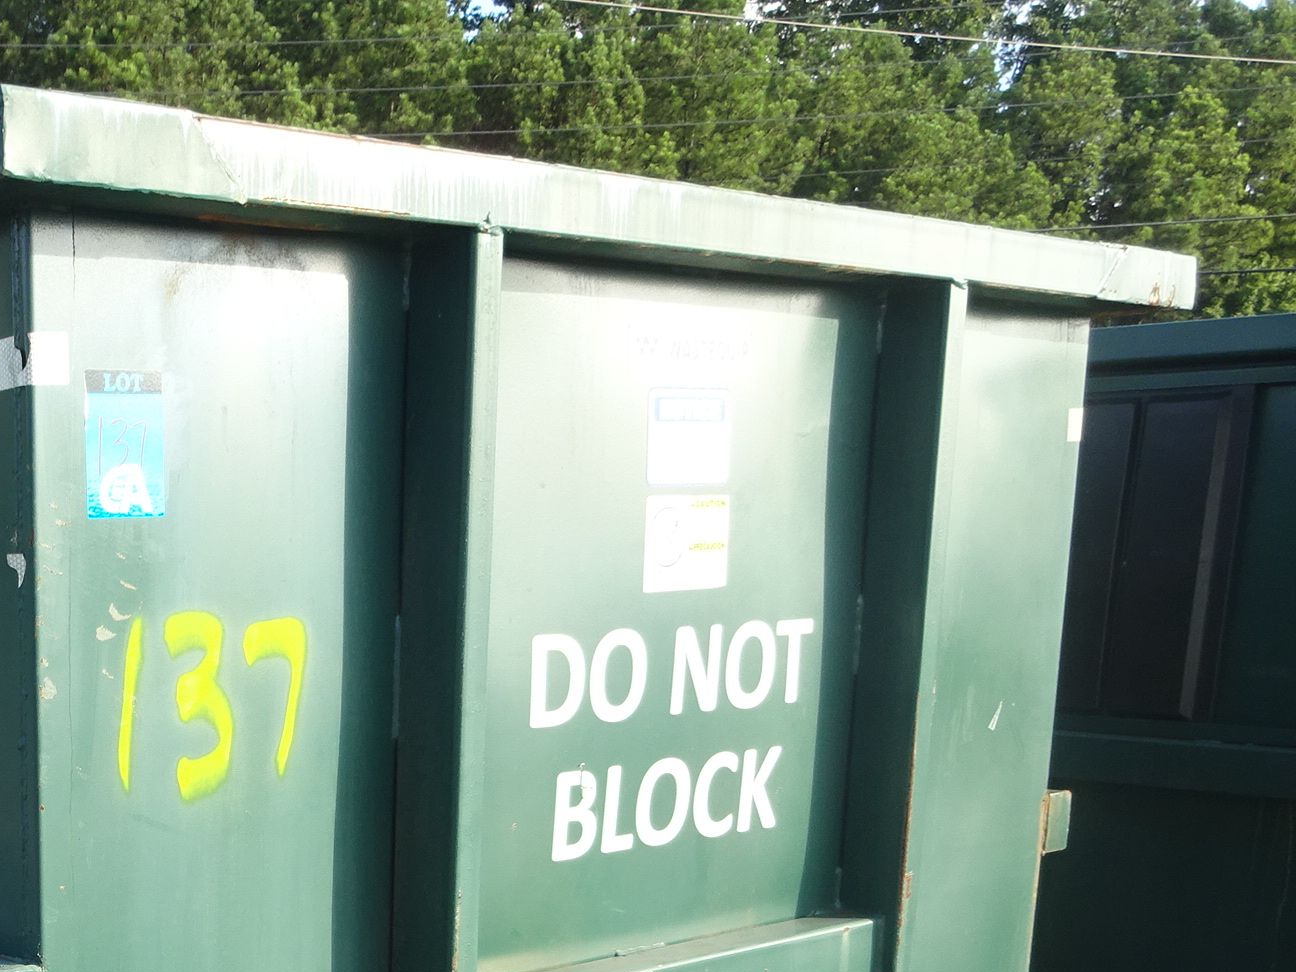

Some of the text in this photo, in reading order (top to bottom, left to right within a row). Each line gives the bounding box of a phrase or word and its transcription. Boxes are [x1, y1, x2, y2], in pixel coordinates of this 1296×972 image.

[103, 373, 145, 392] LOT
[98, 415, 148, 477] 137
[118, 610, 308, 803] 137
[530, 618, 814, 728] DO NOT
[552, 746, 783, 862] BLOCK
